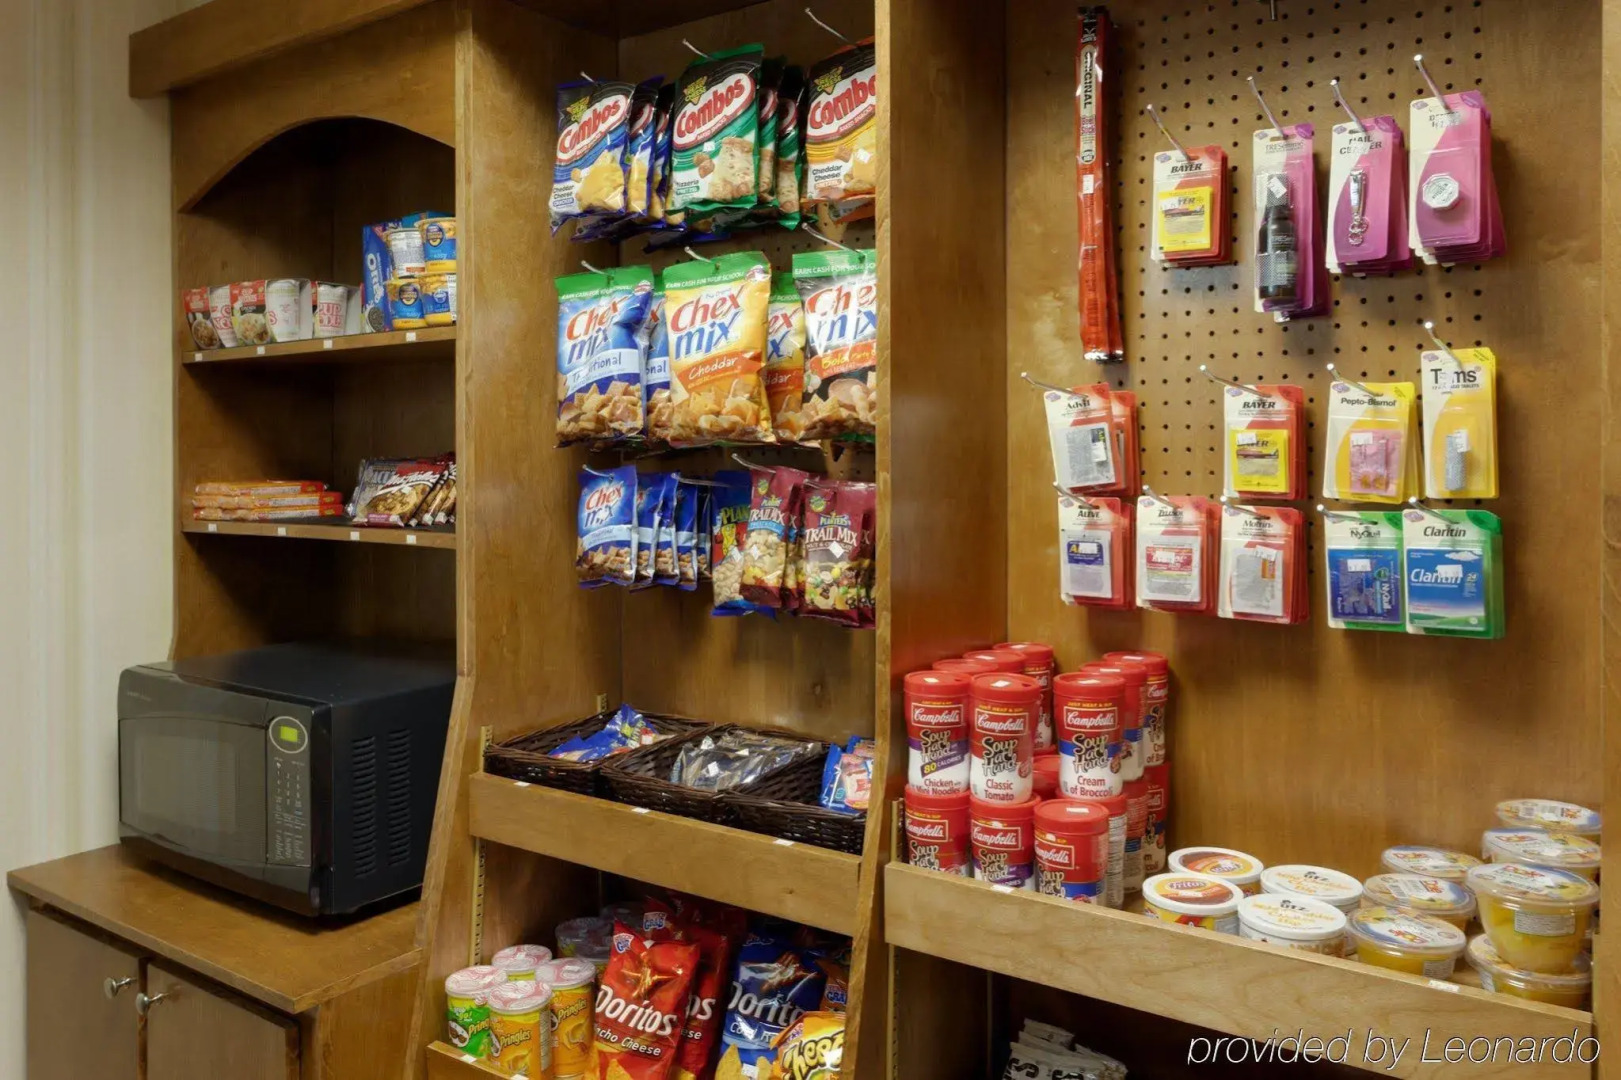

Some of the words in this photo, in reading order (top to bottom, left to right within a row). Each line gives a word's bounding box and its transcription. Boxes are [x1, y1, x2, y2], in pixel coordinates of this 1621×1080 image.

[676, 78, 746, 138] Combos
[559, 100, 622, 154] Combos
[812, 164, 843, 176] Cheddar
[814, 172, 842, 182] Cheese
[1170, 162, 1204, 174] BAYER
[794, 266, 813, 276] EARN
[813, 265, 831, 275] CASH
[681, 278, 696, 287] CASH
[671, 284, 746, 333] Chex
[674, 309, 742, 361] mix
[688, 356, 739, 380] Cheddar
[1242, 401, 1276, 409] BAYER
[1341, 397, 1397, 408] Pepto-Bismol
[585, 480, 625, 512] Chex
[804, 529, 835, 544] TRAIL
[836, 530, 858, 548] MIX
[1350, 529, 1381, 542] NyQuil
[1423, 525, 1467, 537] Claritin
[919, 728, 952, 752] Soup
[1072, 733, 1109, 756] Soup
[982, 736, 1019, 764] Soup
[923, 763, 937, 777] 80
[981, 754, 1018, 777] Hand
[1073, 749, 1110, 774] Hand
[923, 779, 954, 788] Chicken
[985, 780, 1013, 791] Classic
[1077, 775, 1106, 787] Cream
[931, 786, 961, 796] Noodles
[984, 790, 1015, 801] Tomato
[1069, 786, 1079, 795] of
[1080, 786, 1114, 798] Broccoli
[909, 840, 940, 863] Soup
[978, 848, 1009, 868] Soup
[557, 998, 587, 1023] Pringles
[595, 984, 679, 1037] Doritos
[500, 1028, 532, 1051] Pringles
[597, 1026, 619, 1043] acho
[621, 1037, 662, 1057] Cheese
